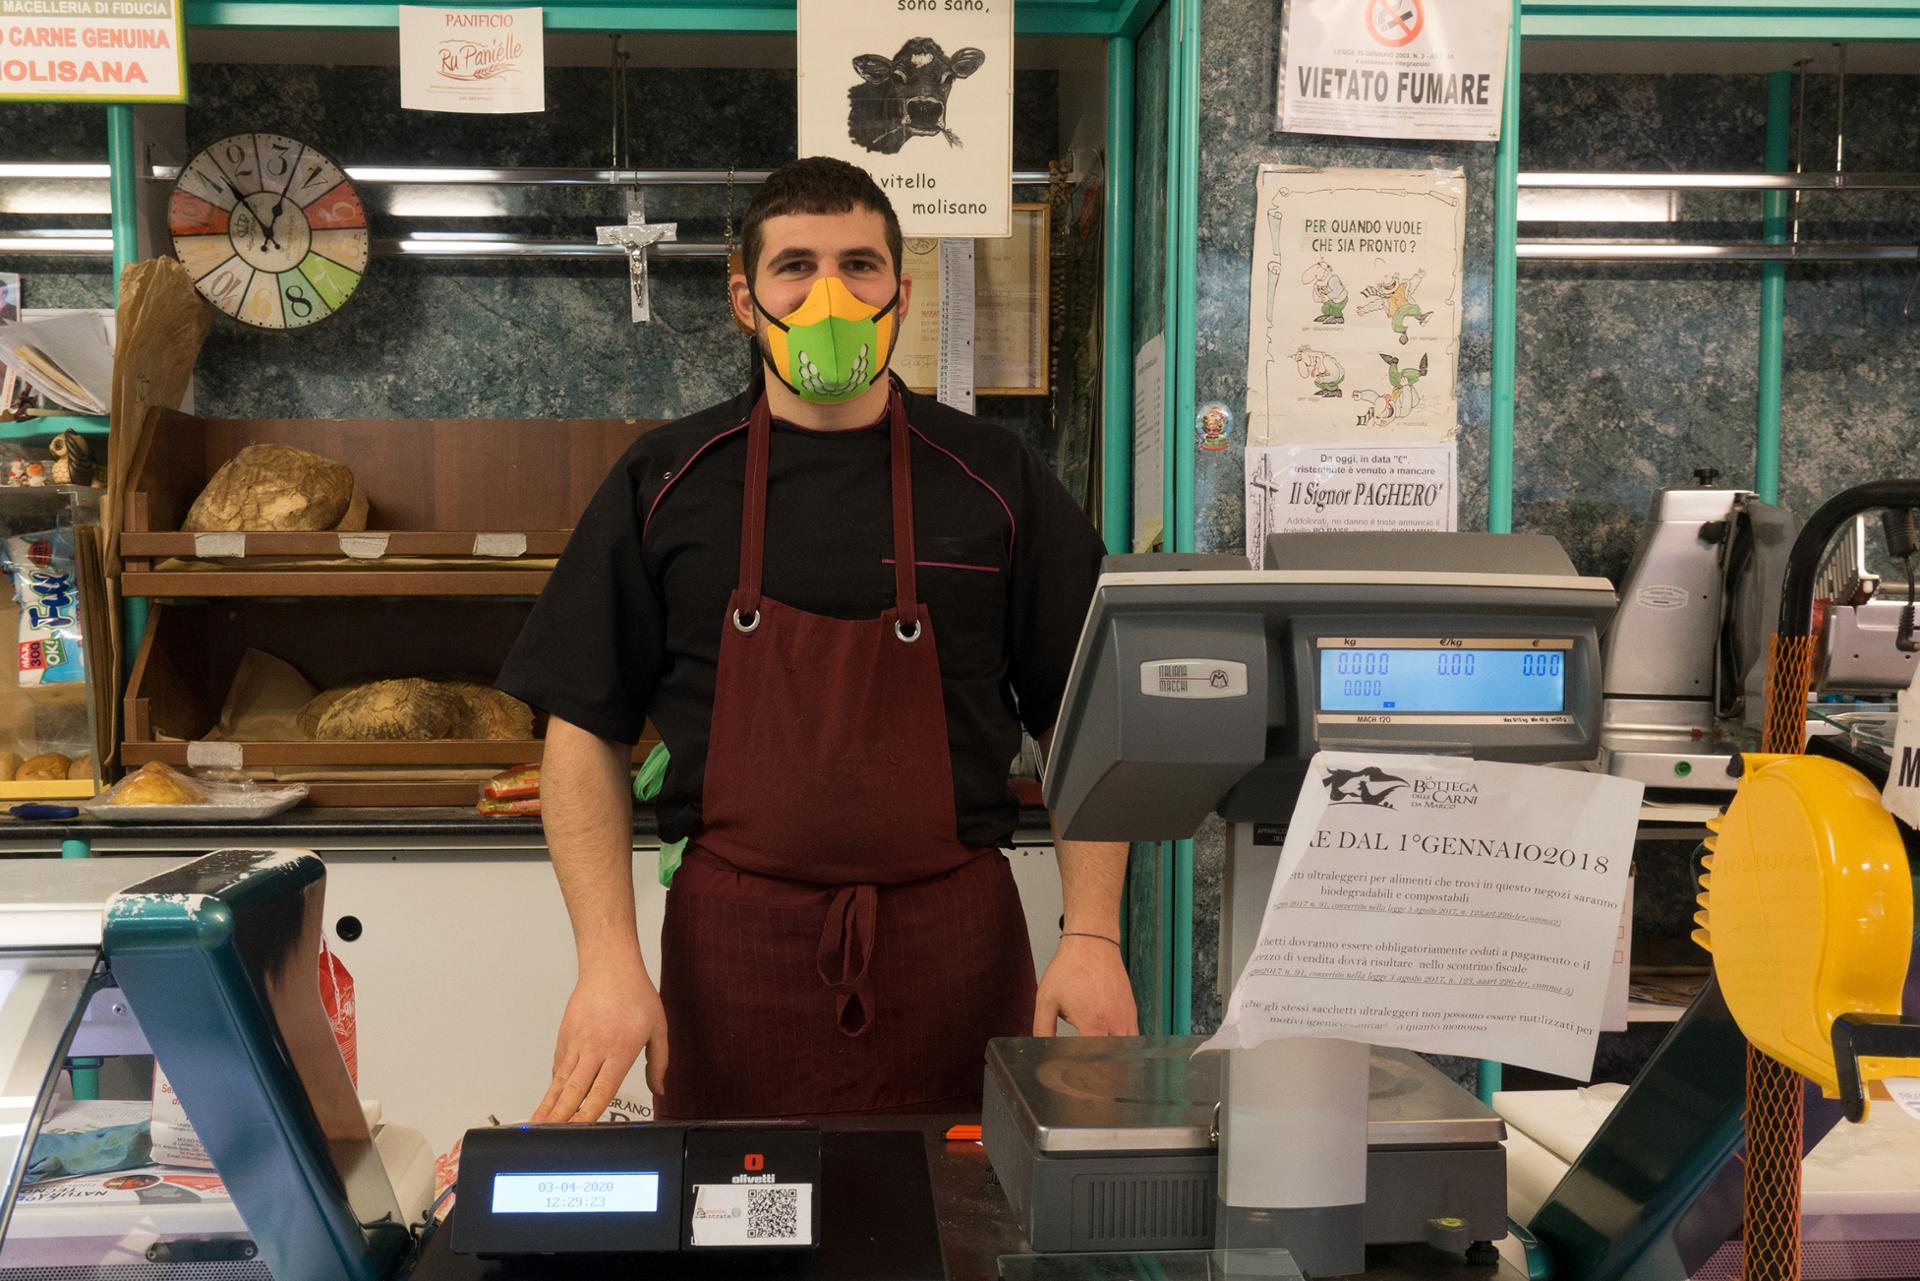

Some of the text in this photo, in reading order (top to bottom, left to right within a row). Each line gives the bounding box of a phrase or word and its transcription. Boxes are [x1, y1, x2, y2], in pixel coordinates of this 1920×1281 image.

[3, 1, 167, 15] MACELLERIA DI FIDUCIA
[897, 0, 990, 13] sono sano,
[445, 14, 514, 27] PANIFICIO
[9, 26, 77, 48] CARNE
[82, 28, 170, 49] GENUINA
[0, 59, 149, 83] OLISANA
[1298, 65, 1490, 104] VIETATO FUMARE
[226, 144, 252, 178] 2
[266, 143, 289, 176] 3
[881, 173, 936, 188] vitello
[912, 199, 987, 214] molisano
[1305, 219, 1422, 235] PER QUANDO VUOLE
[1312, 239, 1332, 252] CHE
[1338, 239, 1355, 252] SIA
[285, 285, 313, 318] 8
[1336, 455, 1358, 466] oggi,
[1360, 455, 1369, 463] in
[1371, 455, 1391, 464] data
[1356, 467, 1387, 475] venuto
[1397, 467, 1436, 475] mancare
[1289, 481, 1445, 513] Il Signor PAGHERO'
[1343, 518, 1368, 526] danno
[1377, 518, 1396, 526] triste
[1398, 518, 1435, 526] annuncio
[1344, 639, 1356, 648] kg
[1439, 639, 1463, 648] €/kg
[31, 642, 41, 666] 300
[46, 639, 60, 666] OK!
[1338, 653, 1559, 676] 0.000 0.00 0.00
[1344, 680, 1381, 697] 0.000
[1357, 716, 1391, 724] MACH 120
[1339, 831, 1389, 851] DAL
[1307, 870, 1368, 884] ultraleggeri
[1369, 874, 1387, 884] per
[1389, 873, 1432, 886] alimenti
[1434, 877, 1452, 887] che
[1455, 878, 1480, 889] trovi
[1483, 879, 1493, 889] in
[1496, 883, 1531, 895] questo
[1534, 886, 1571, 900] negozi
[1574, 893, 1618, 909] saranno
[1320, 885, 1393, 899] biodegradabili
[1404, 892, 1470, 904] compostabili
[1283, 952, 1294, 961] di
[1296, 954, 1335, 965] vendita
[1337, 954, 1368, 966] dovrà
[1369, 957, 1414, 968] risultare
[1418, 961, 1444, 970] nello
[1446, 961, 1493, 971] scontrino
[1495, 961, 1527, 974] fiscale
[1288, 938, 1339, 949] dovranno
[1341, 942, 1372, 950] essere
[1375, 942, 1468, 955] obbligatoriamente
[1470, 946, 1499, 957] ceduti
[1510, 950, 1571, 966] pagamento
[1582, 960, 1591, 971] il
[1264, 1002, 1279, 1012] gli
[1281, 1004, 1310, 1012] stessi
[1312, 1005, 1357, 1015] sacchetti
[1360, 1006, 1419, 1018] ultraleggeri
[1422, 1010, 1442, 1018] non
[1443, 1012, 1485, 1021] possono
[1519, 1013, 1574, 1031] riutilizzati
[1576, 1025, 1594, 1035] per
[1269, 1016, 1304, 1025] motivi
[1405, 1024, 1441, 1032] quanto
[732, 1174, 775, 1183] olivetti
[538, 1182, 614, 1193] 03-04-2020
[545, 1197, 606, 1208] 12:29:23
